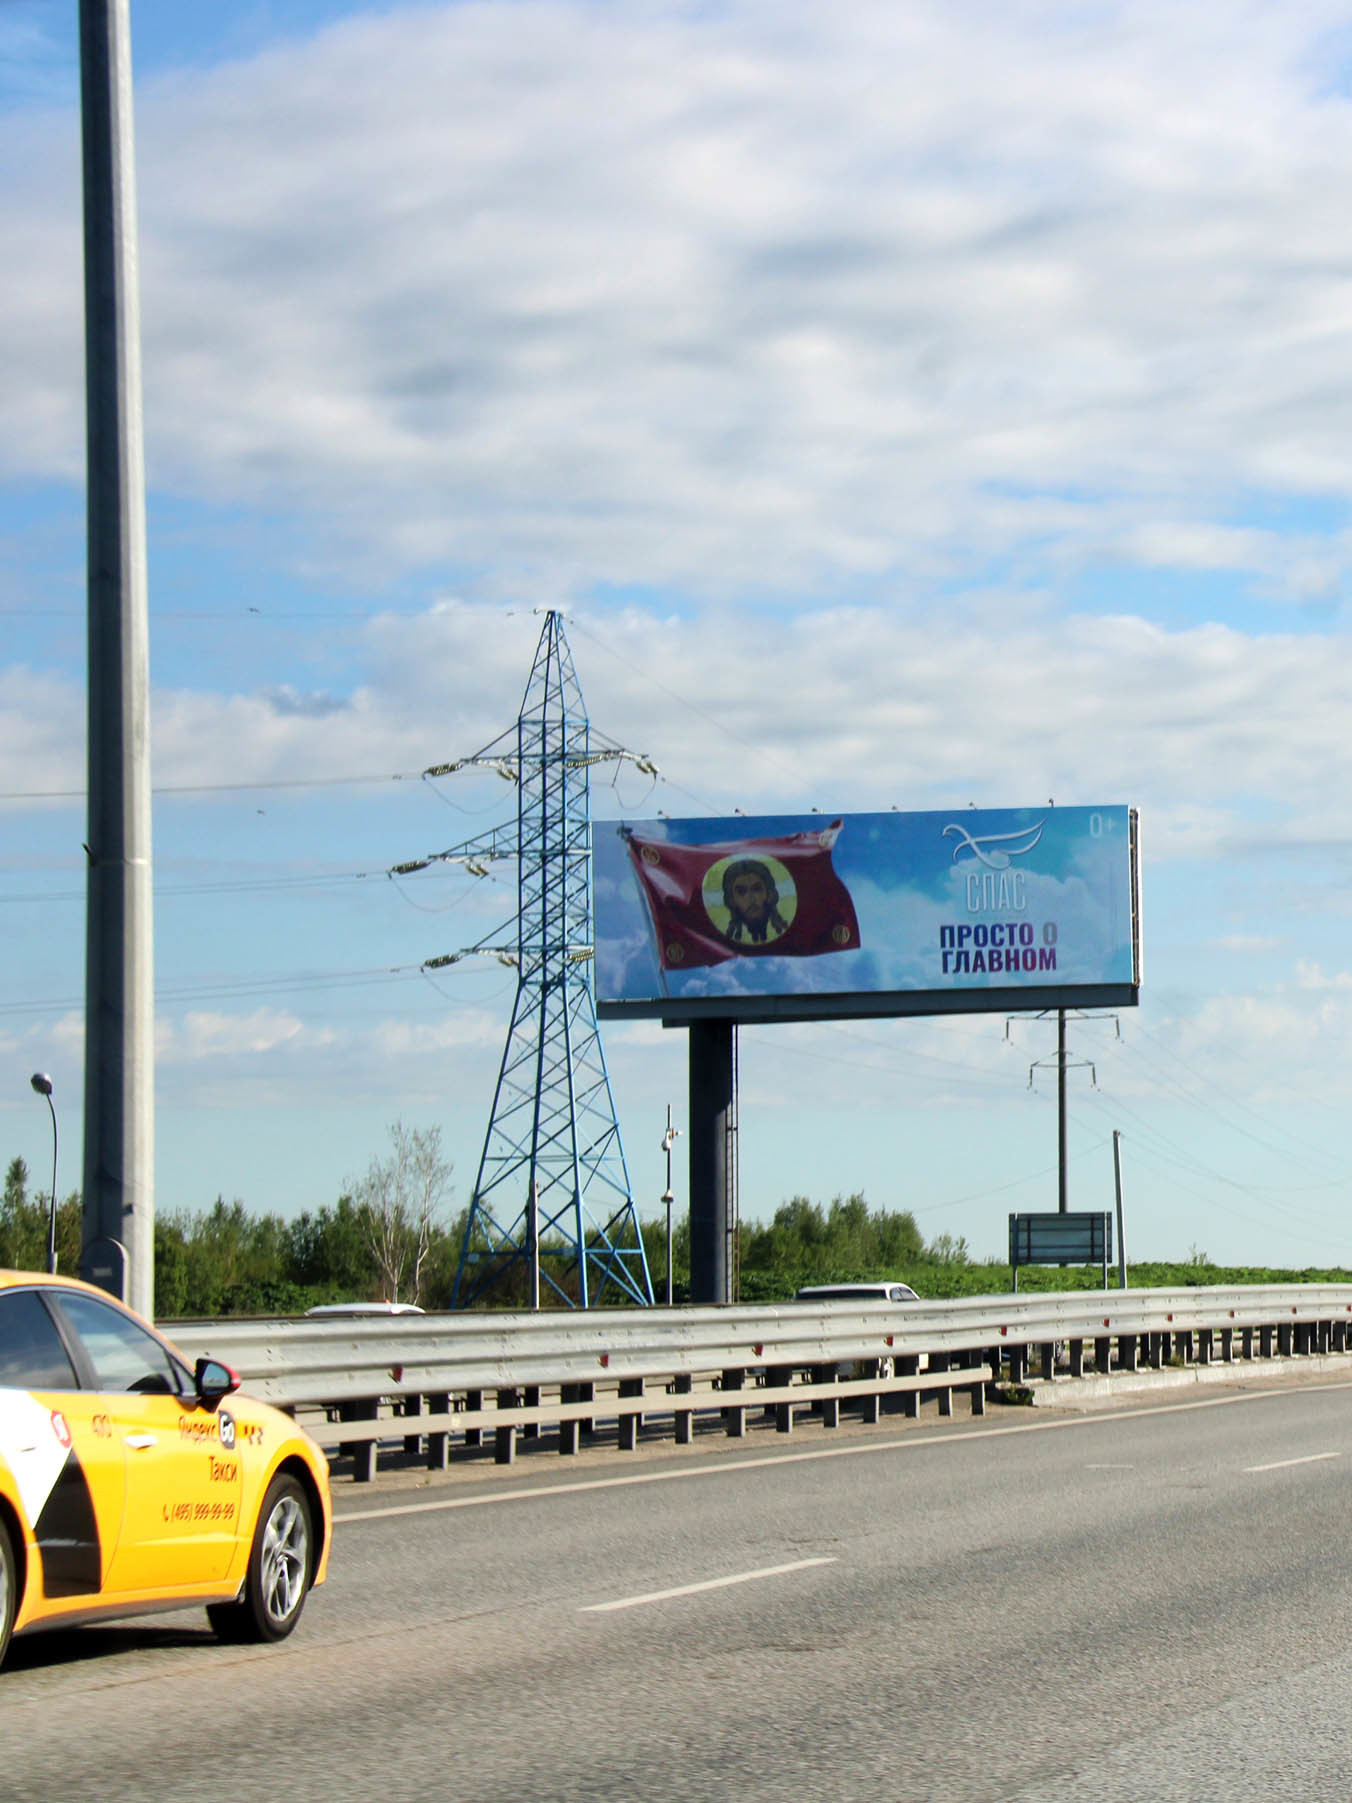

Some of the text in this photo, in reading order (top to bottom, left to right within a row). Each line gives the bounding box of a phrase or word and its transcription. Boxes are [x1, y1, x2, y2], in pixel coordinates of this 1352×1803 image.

[966, 870, 1027, 913] СПАС
[939, 921, 1058, 949] ПРОСТО О
[941, 947, 1057, 974] ГЛАВНОМ
[208, 1455, 238, 1481] Такси
